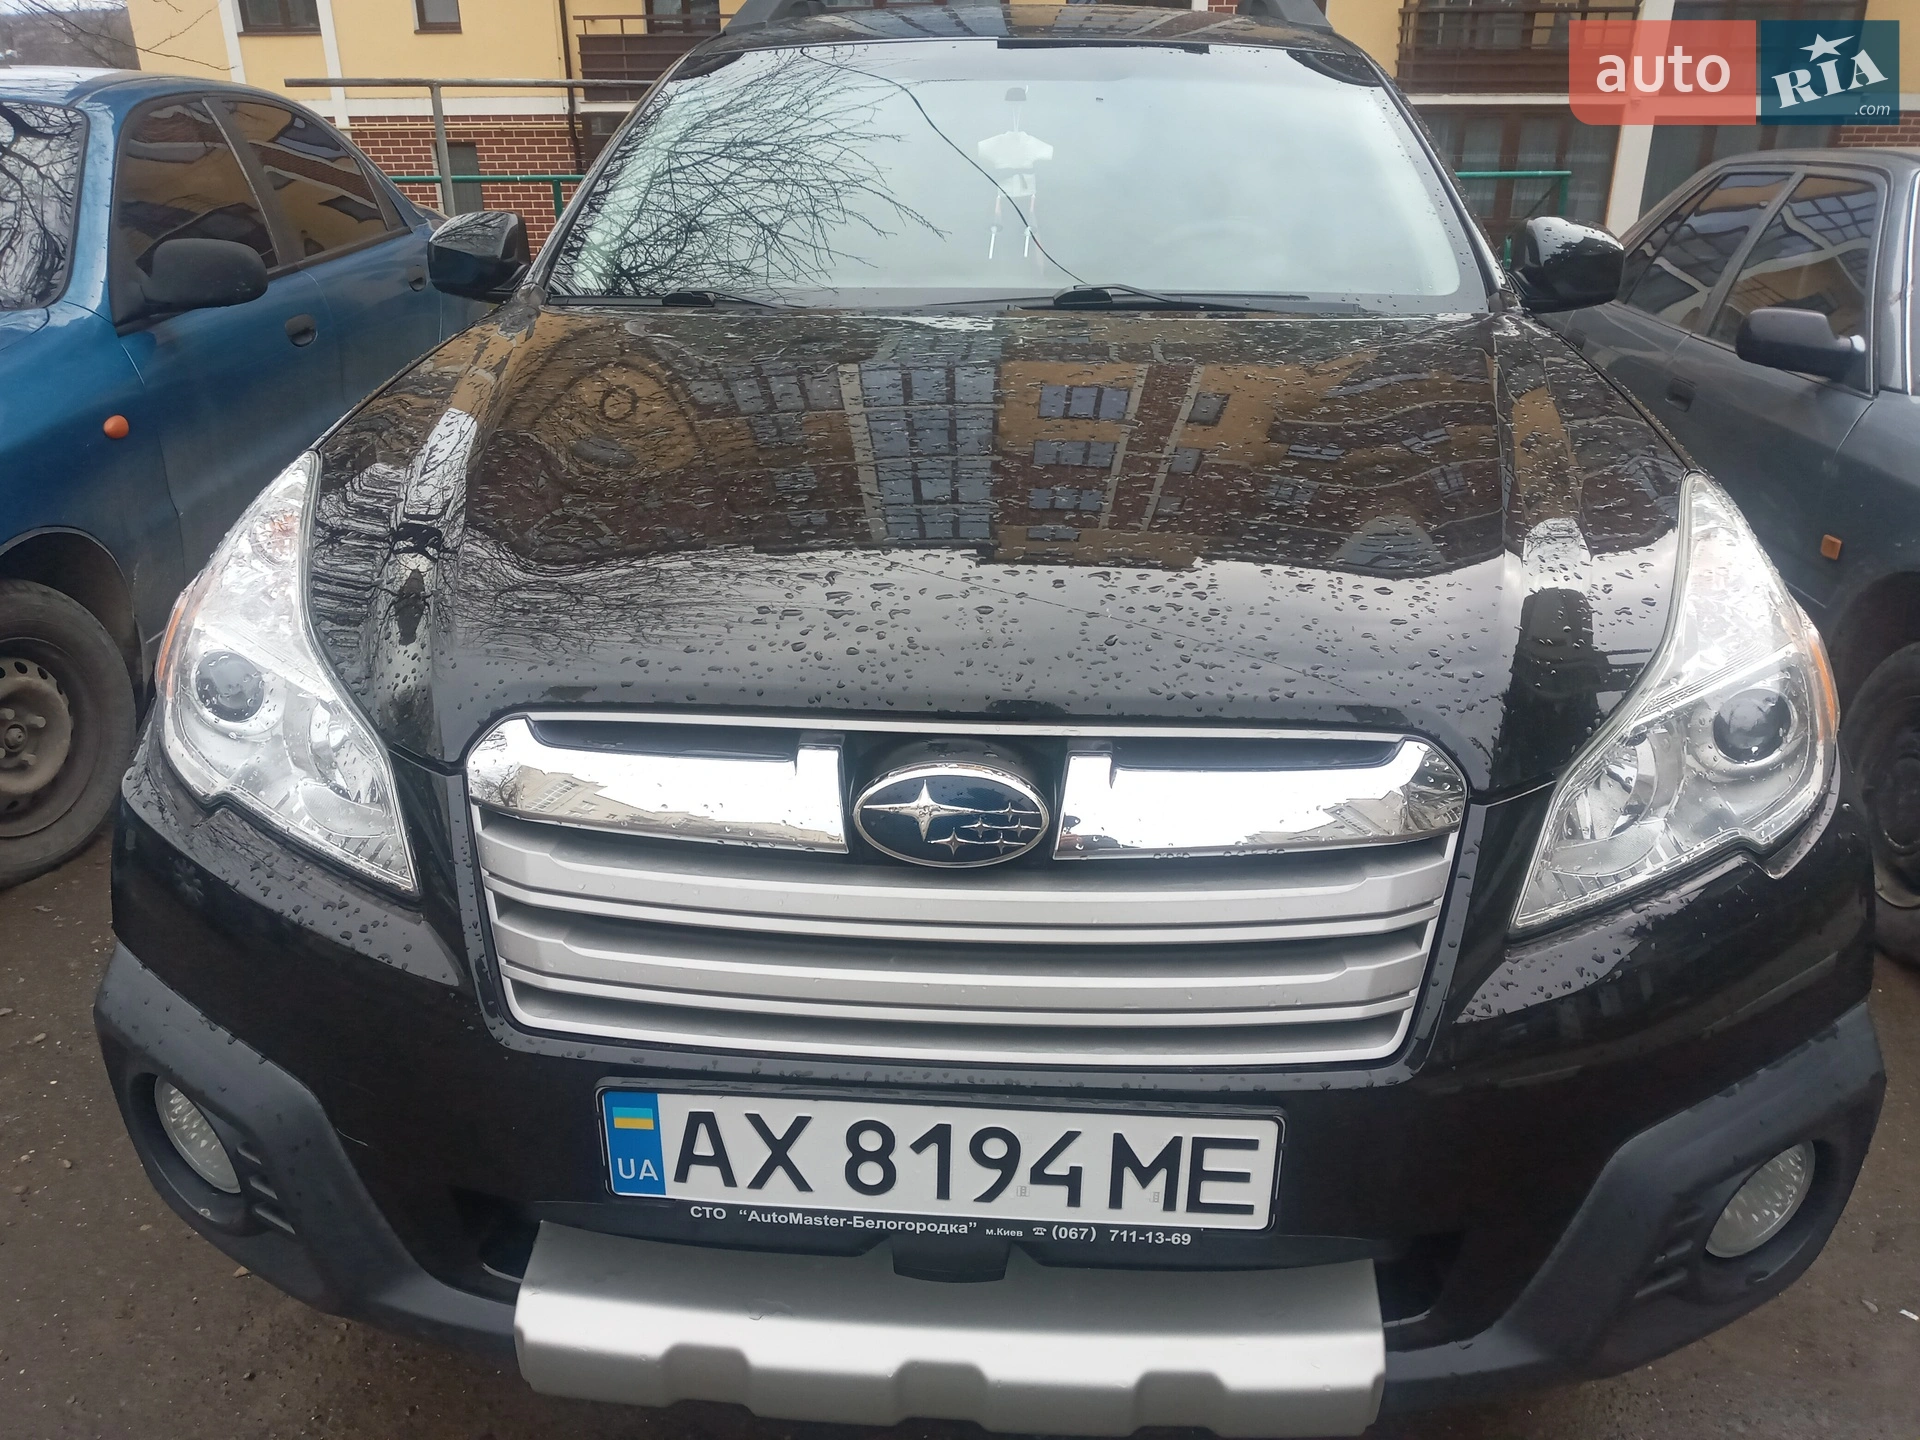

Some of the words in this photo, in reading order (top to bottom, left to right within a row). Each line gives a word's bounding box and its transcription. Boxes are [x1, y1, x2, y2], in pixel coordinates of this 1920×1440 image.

[617, 1157, 659, 1181] UA
[674, 1111, 813, 1192] AX
[844, 1119, 1083, 1208] 8194
[1109, 1132, 1260, 1215] ME
[690, 1206, 727, 1220] СТО
[985, 1228, 1024, 1237] м.Киев
[1051, 1226, 1097, 1242] (067)
[1109, 1229, 1192, 1245] 711-13-69
